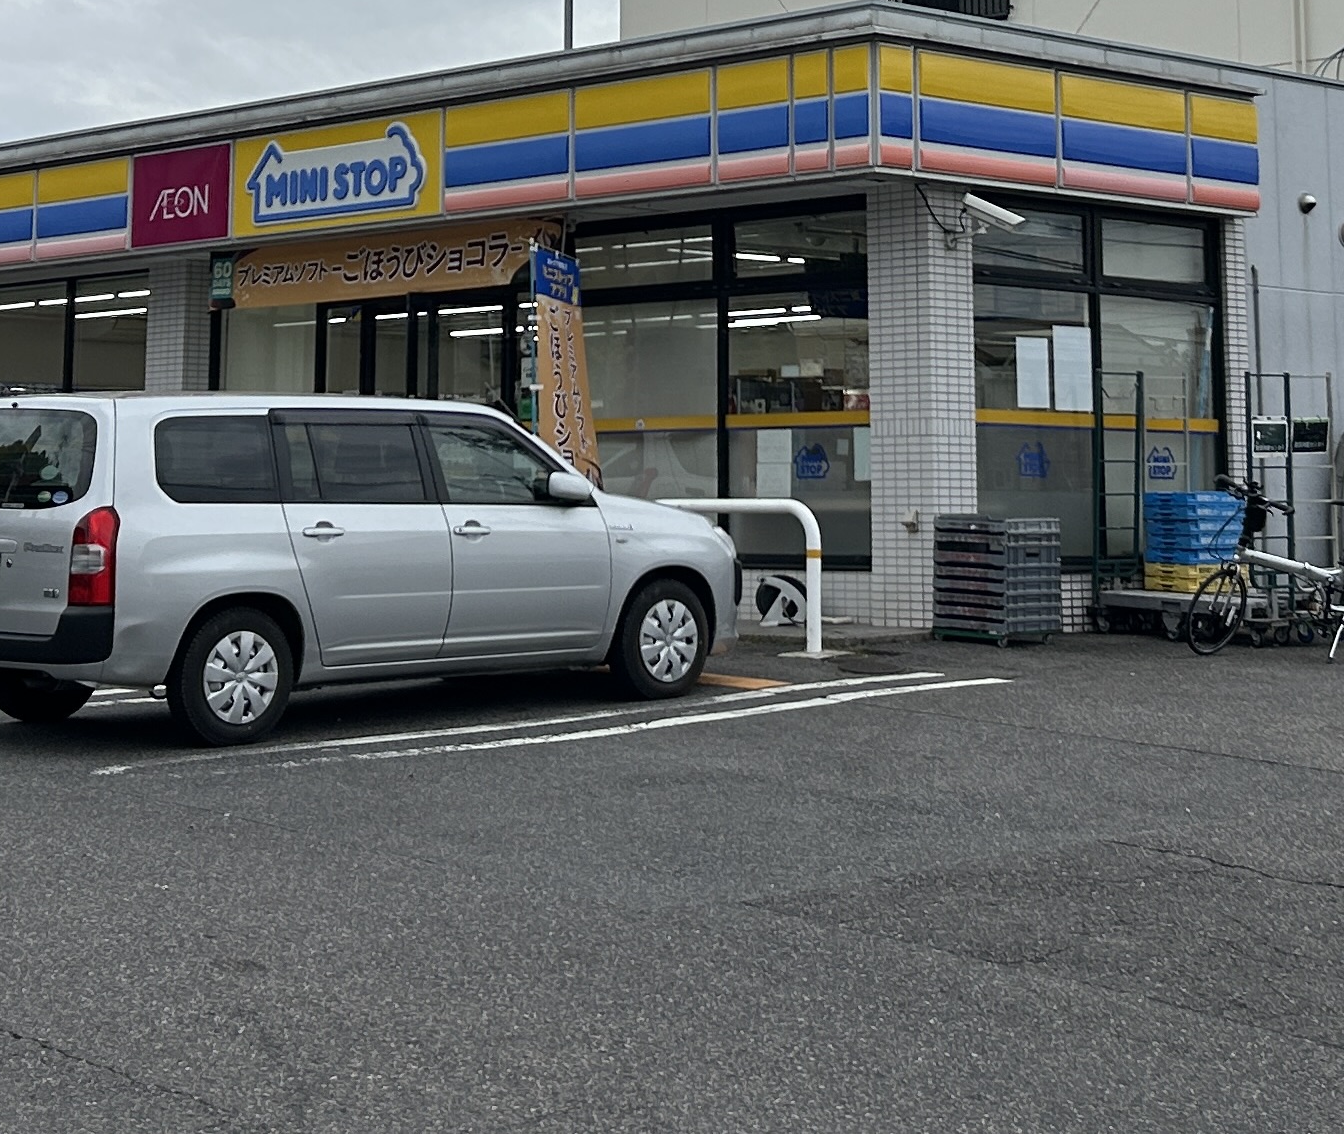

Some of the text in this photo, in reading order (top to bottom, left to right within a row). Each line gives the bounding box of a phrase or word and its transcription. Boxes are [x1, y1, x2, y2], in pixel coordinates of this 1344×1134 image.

[265, 157, 407, 207] MINI STOP
[214, 261, 232, 278] 60
